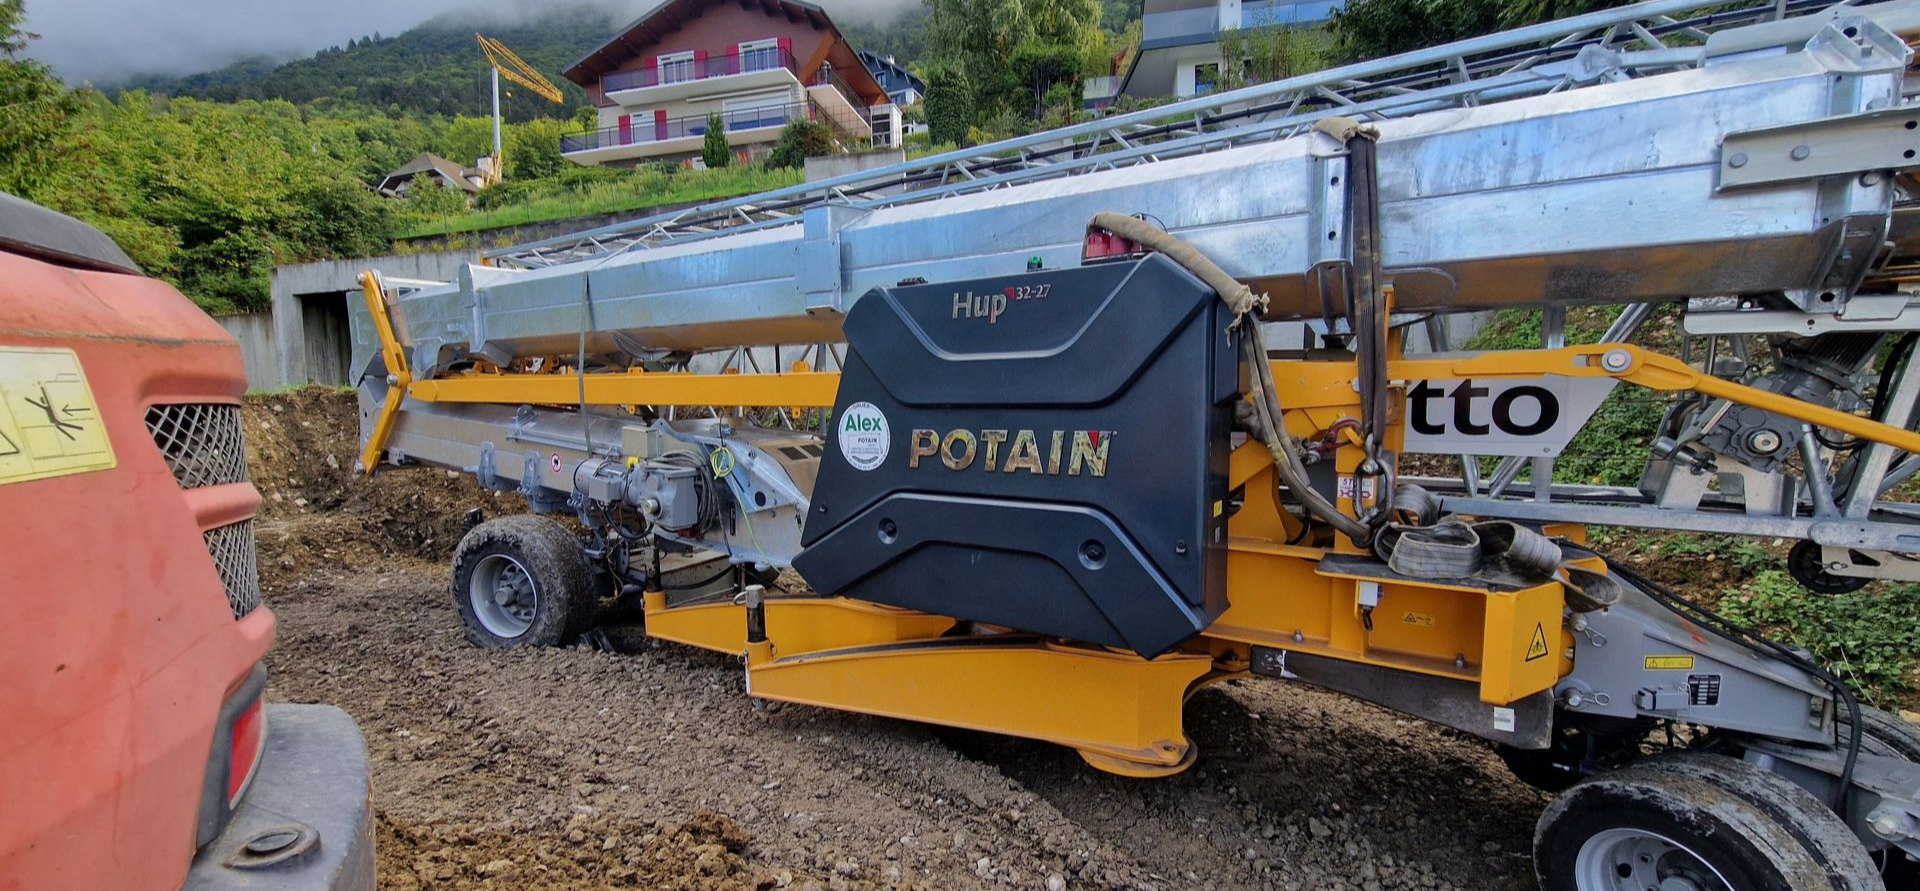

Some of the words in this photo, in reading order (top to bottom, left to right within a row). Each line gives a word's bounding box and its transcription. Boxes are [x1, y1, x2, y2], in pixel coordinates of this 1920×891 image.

[952, 291, 1007, 324] Hup
[1016, 284, 1051, 300] 32-27
[845, 413, 883, 432] Alex
[909, 428, 1112, 477] POTAIN
